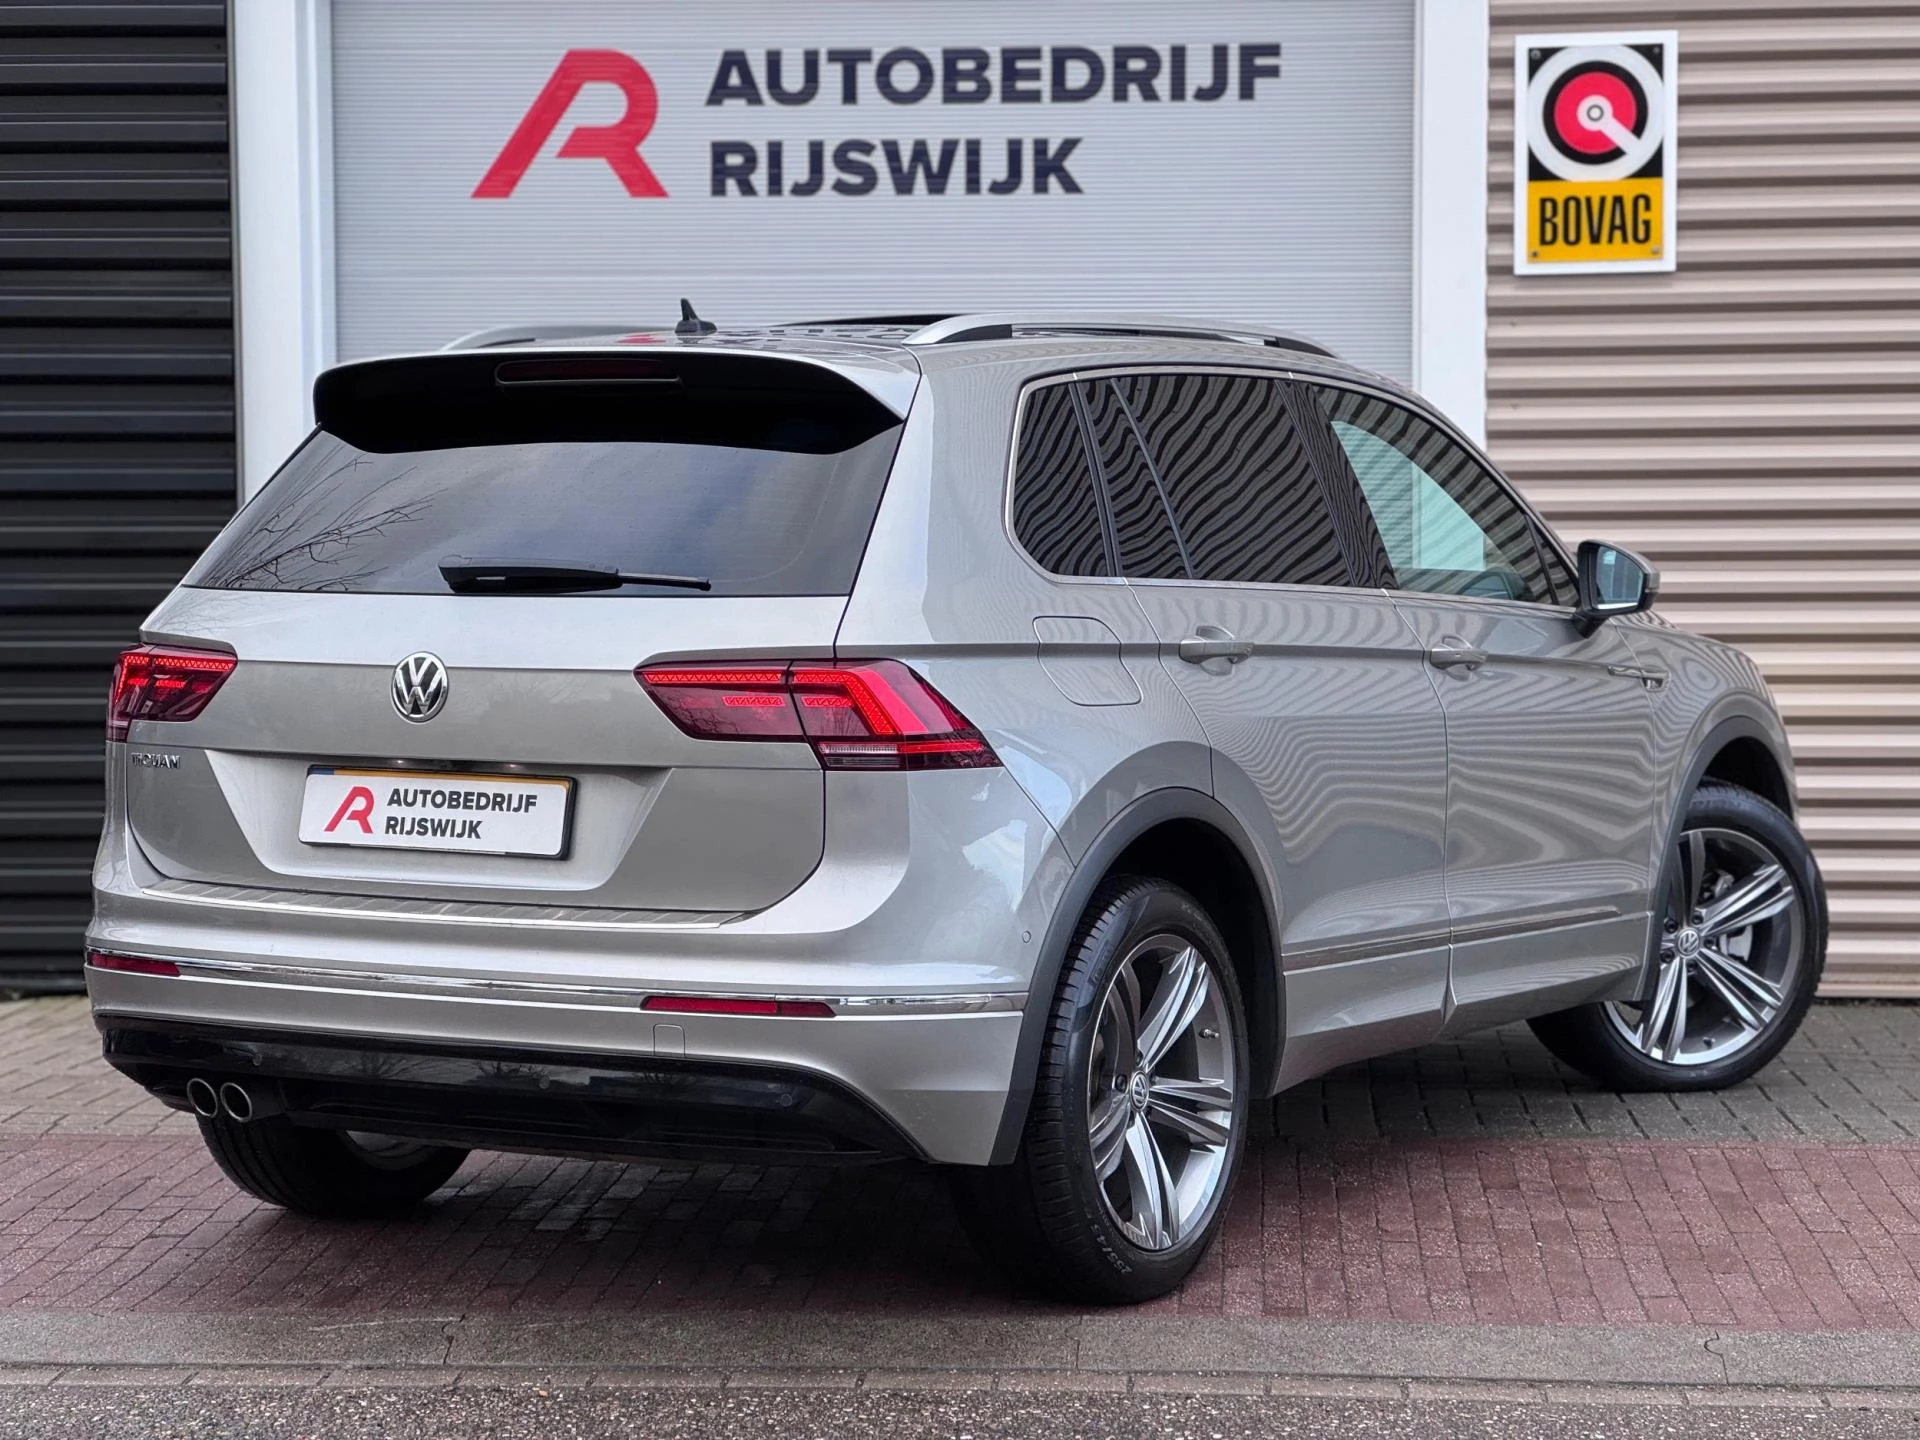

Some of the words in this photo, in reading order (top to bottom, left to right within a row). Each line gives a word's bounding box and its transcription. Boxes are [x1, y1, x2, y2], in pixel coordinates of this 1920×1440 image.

[705, 43, 1282, 107] AUTOBEDRIJF
[710, 138, 1085, 197] RIJSWIJK
[1539, 193, 1652, 246] BOVAG
[386, 788, 538, 813] AUTOBEDRIJF
[384, 816, 482, 839] RIJSWIJK
